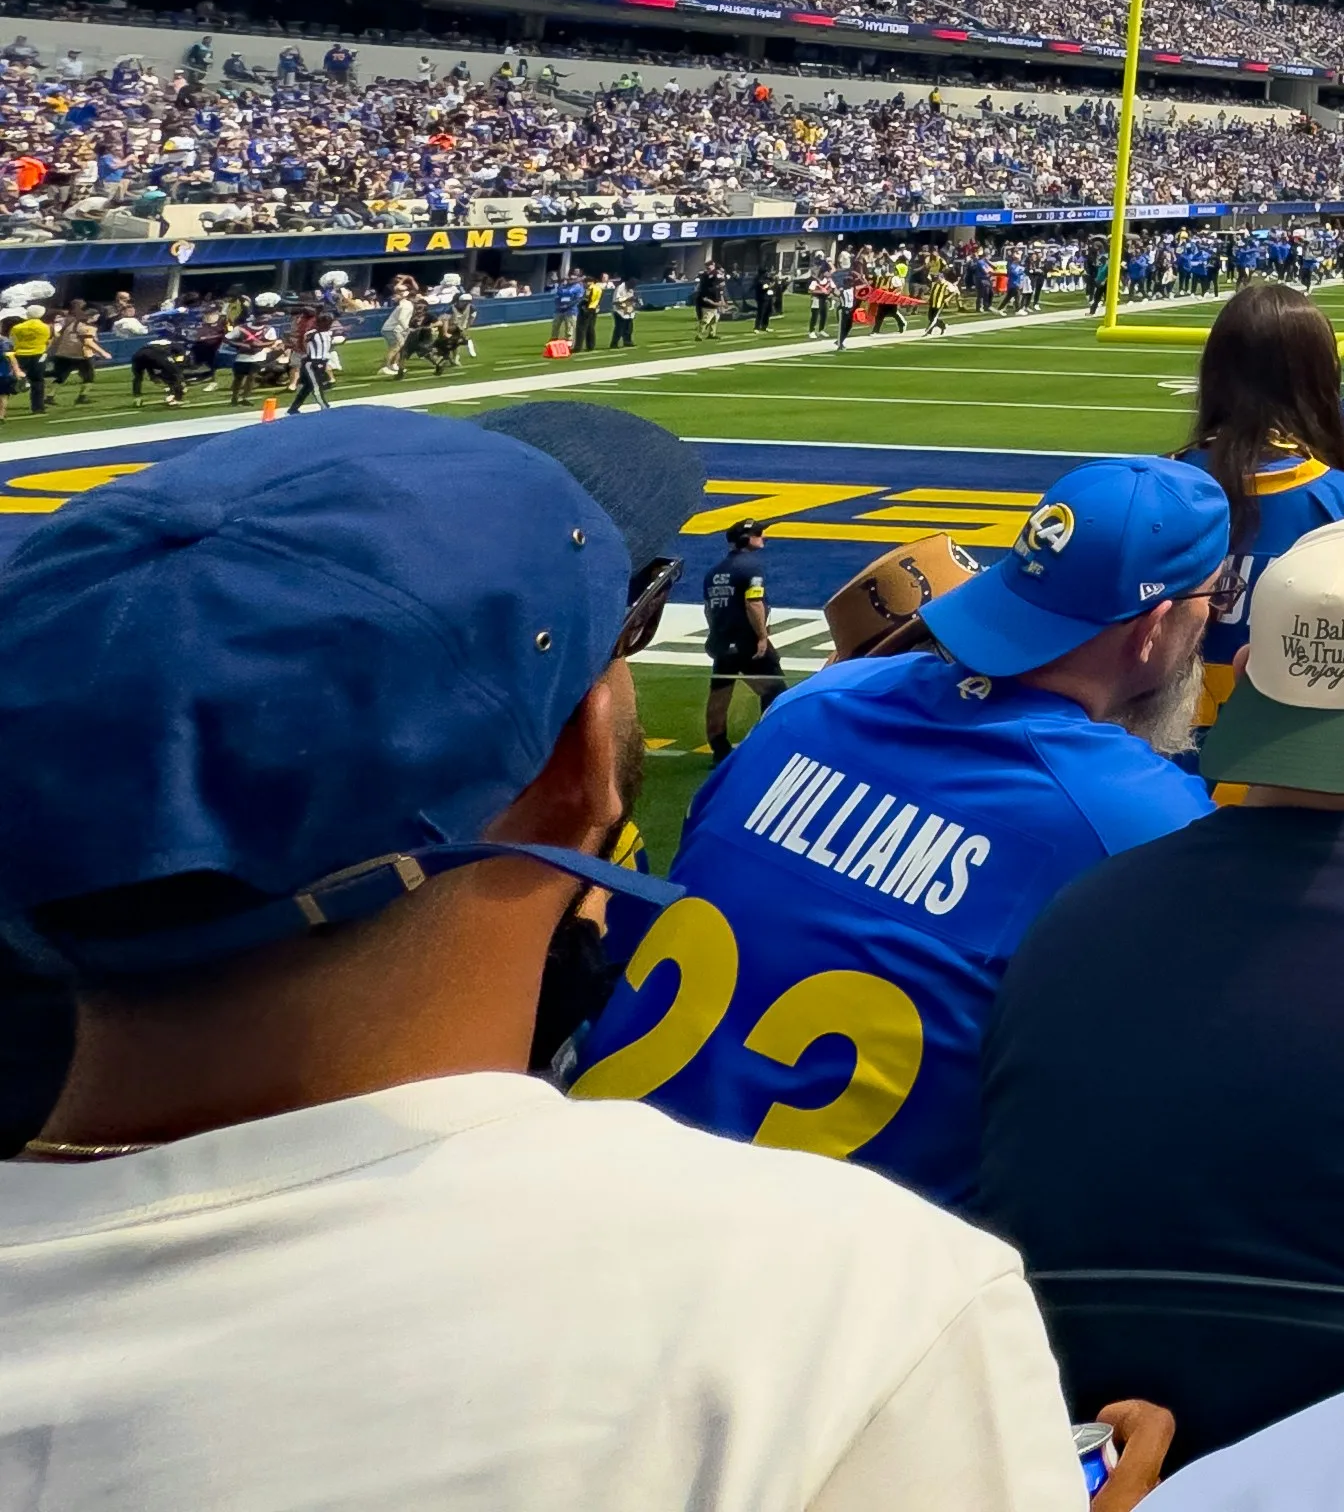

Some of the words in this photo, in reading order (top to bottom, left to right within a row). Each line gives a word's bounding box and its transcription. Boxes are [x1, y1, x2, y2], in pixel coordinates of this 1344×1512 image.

[864, 21, 909, 34] HYUNDAI
[385, 228, 528, 252] RAMS
[559, 221, 698, 245] HOUSE
[1293, 615, 1311, 639] In
[1282, 635, 1305, 664] We
[744, 752, 991, 915] WILLIAMS
